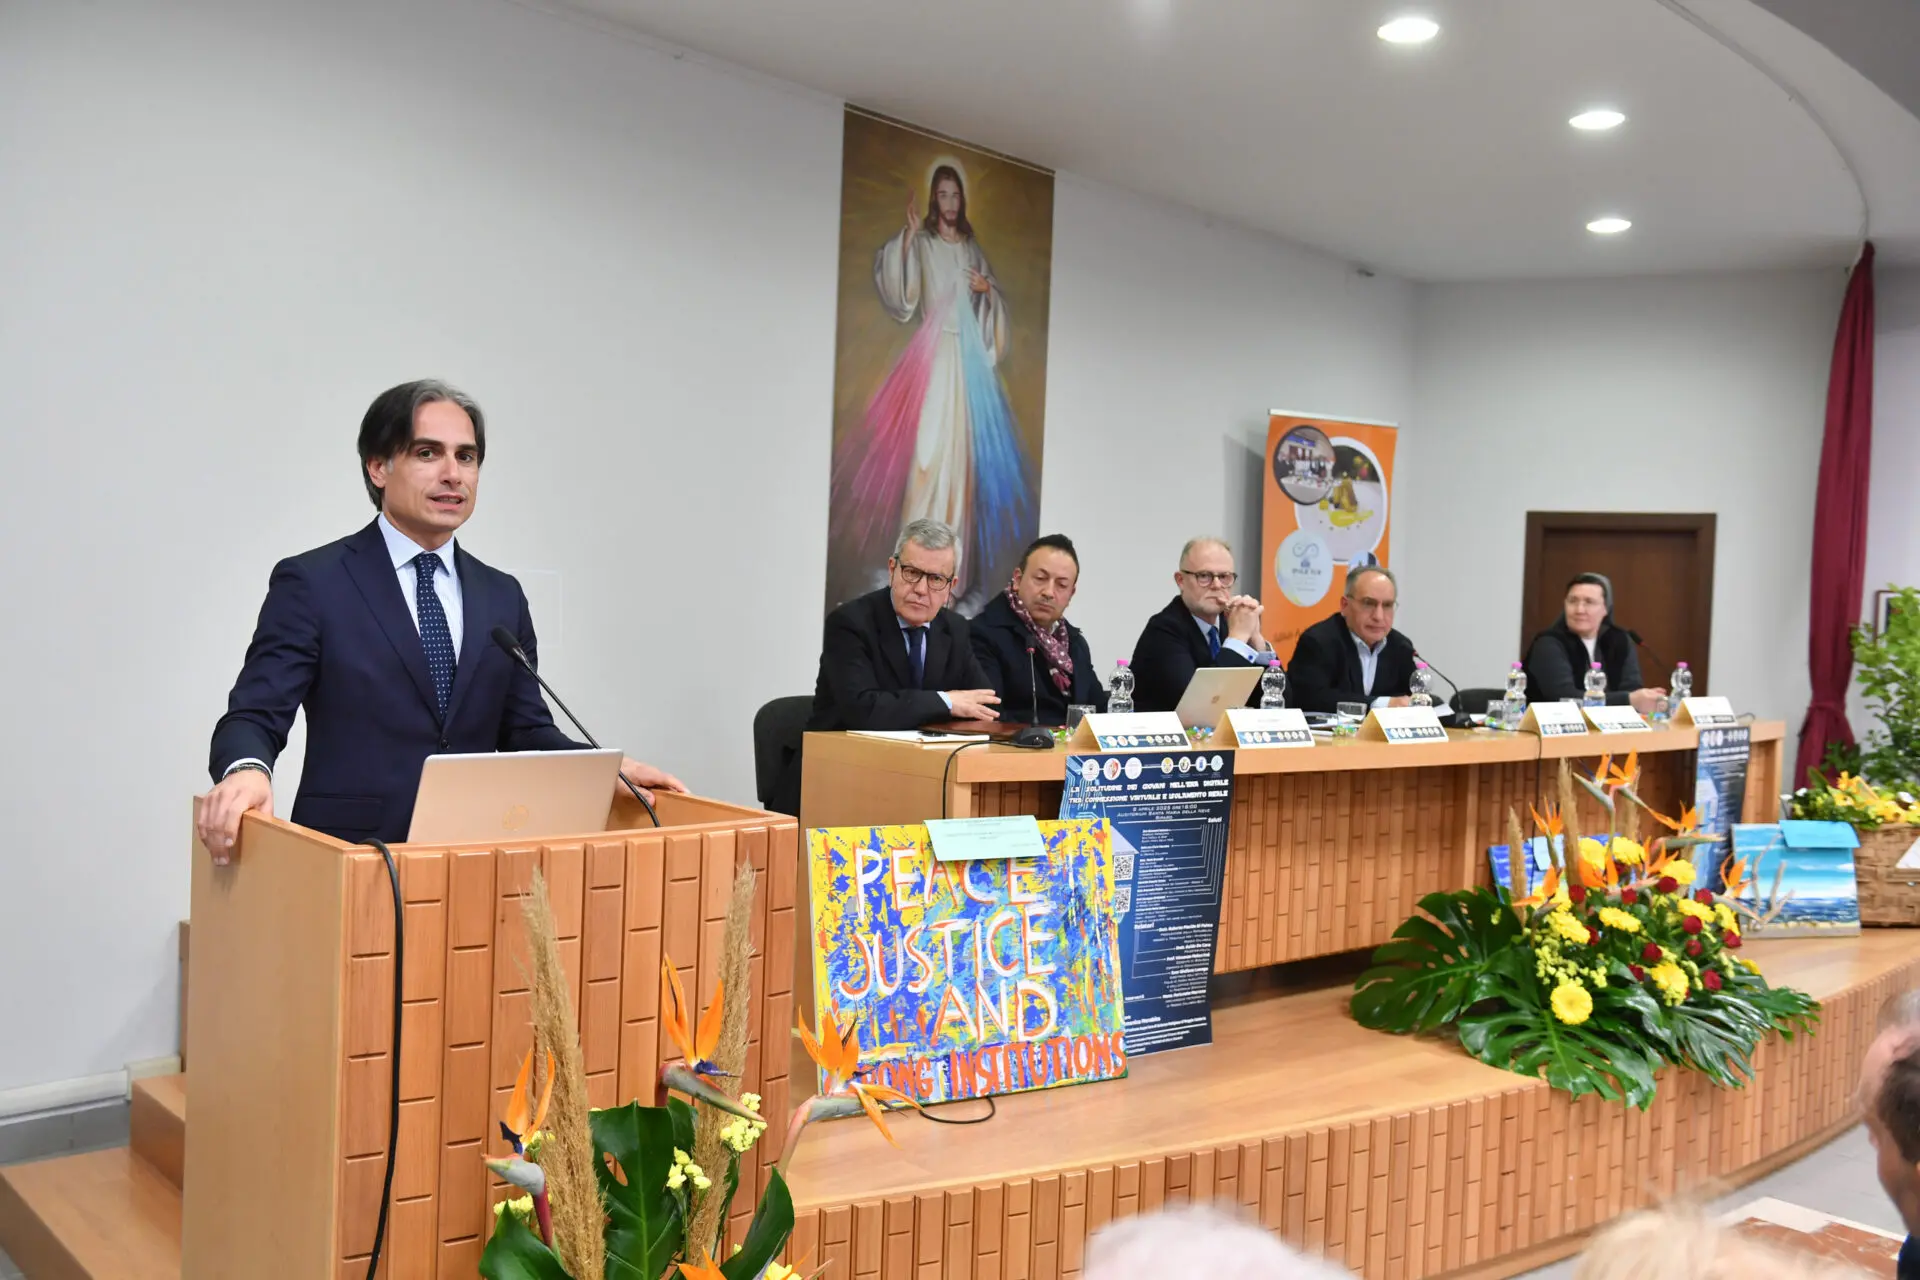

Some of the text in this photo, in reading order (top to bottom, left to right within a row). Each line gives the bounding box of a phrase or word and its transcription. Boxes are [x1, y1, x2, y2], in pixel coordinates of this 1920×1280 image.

[1085, 784, 1122, 793] SOLITUDINE
[1142, 782, 1166, 790] GIOVANI
[1203, 779, 1229, 788] DIGITALE
[1085, 795, 1128, 804] CONNESSIONE
[1130, 793, 1161, 801] VIRTUALE
[1169, 791, 1207, 800] ISOLAMENTO
[1208, 790, 1229, 798] REALE
[854, 846, 1041, 921] PEACE
[839, 902, 1057, 999] JUSTICE
[931, 979, 1058, 1046] AND
[951, 1031, 1127, 1098] INSTITUTIONS
